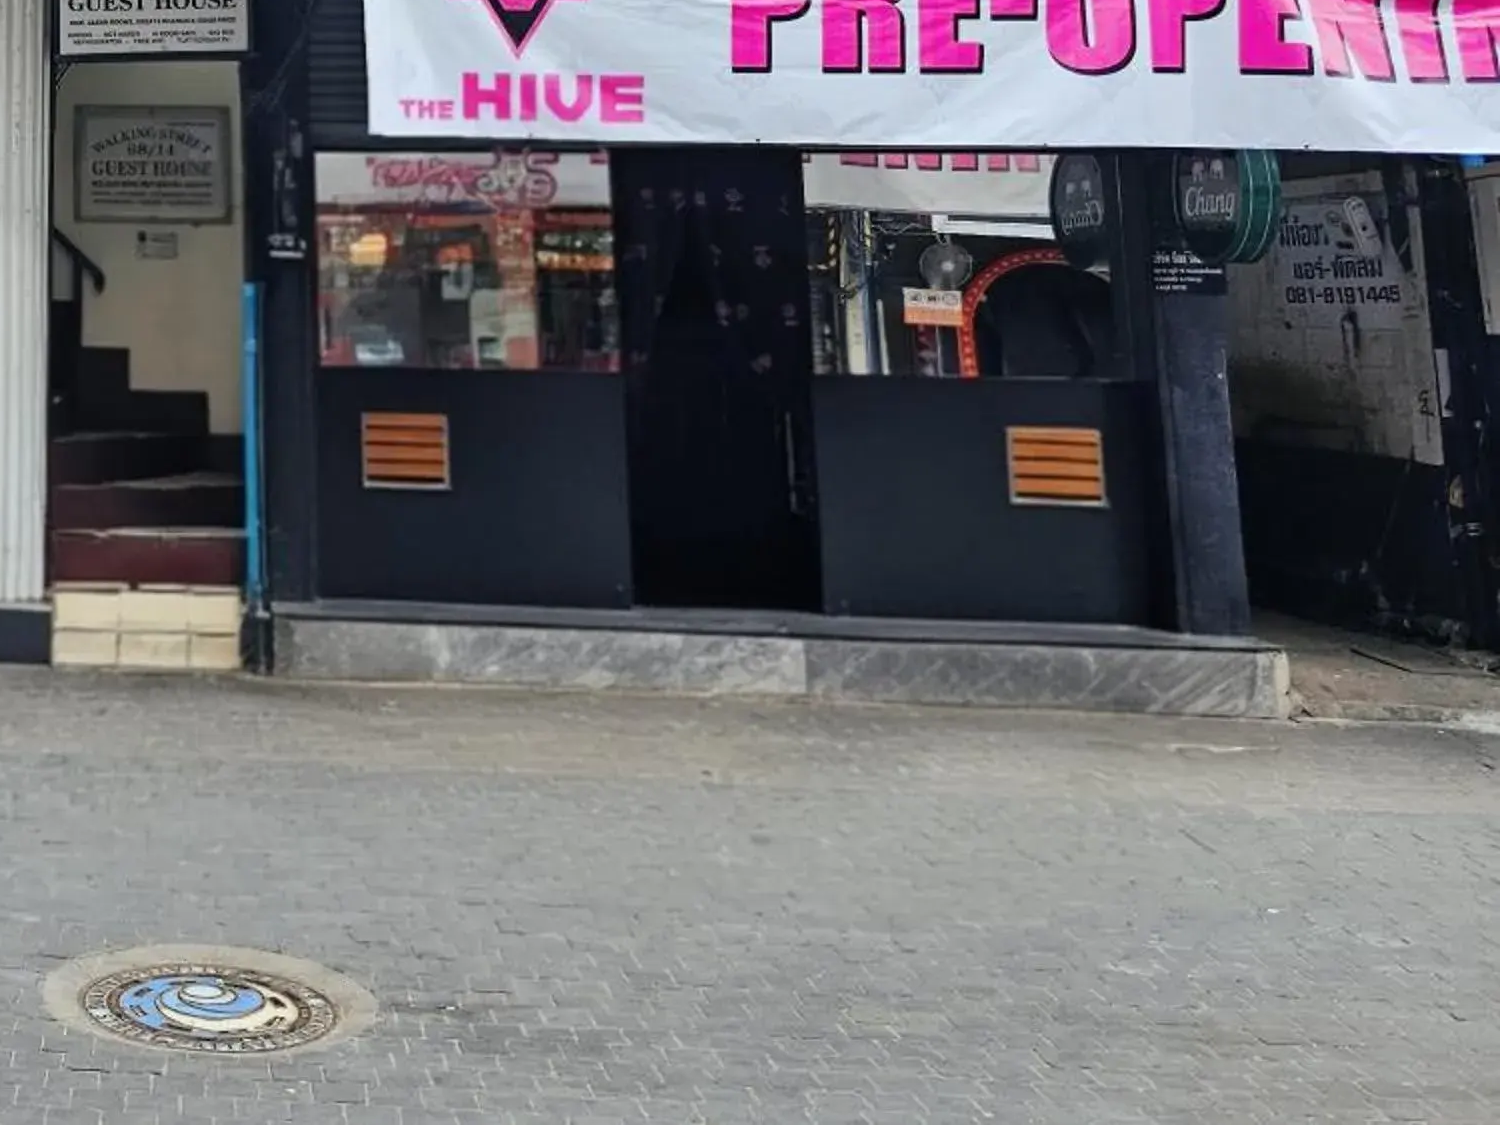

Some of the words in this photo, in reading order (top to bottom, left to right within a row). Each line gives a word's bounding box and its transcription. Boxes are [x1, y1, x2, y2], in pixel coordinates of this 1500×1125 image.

[399, 98, 454, 120] THE
[462, 71, 645, 123] HIVE
[1184, 186, 1236, 220] Chang
